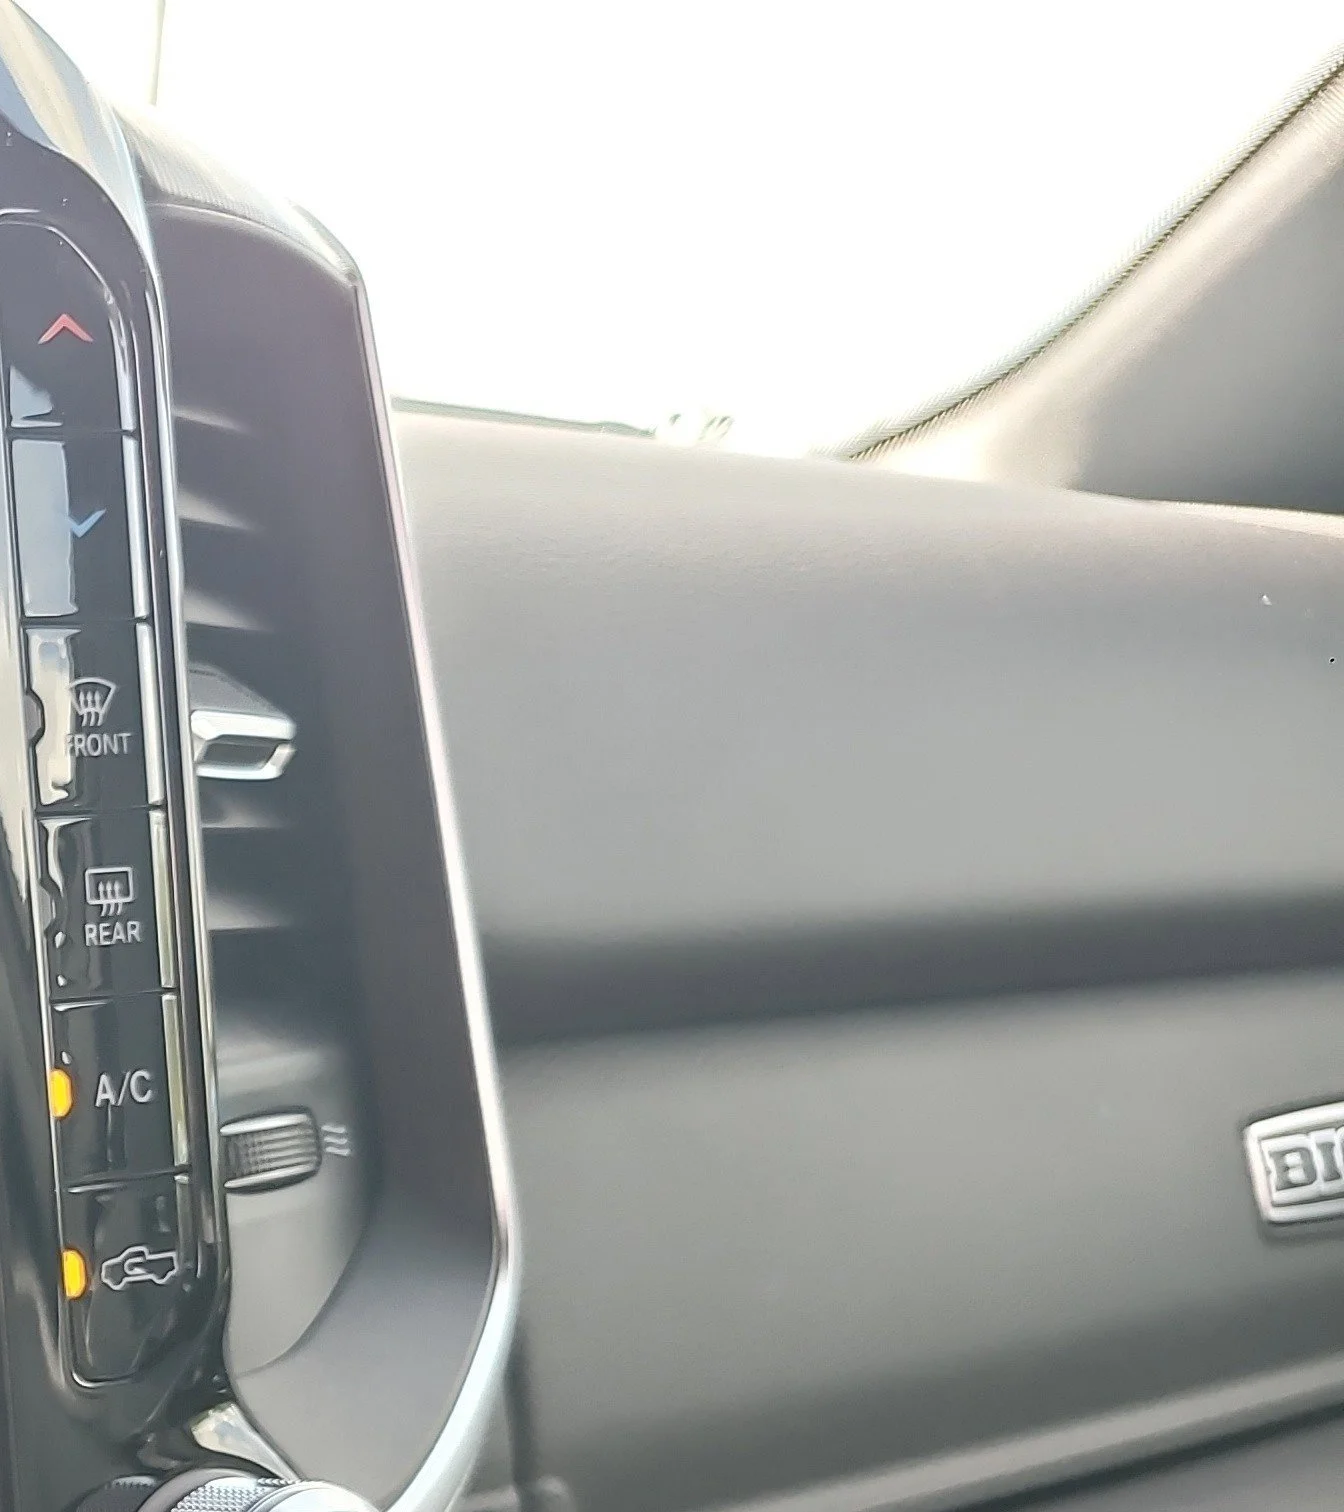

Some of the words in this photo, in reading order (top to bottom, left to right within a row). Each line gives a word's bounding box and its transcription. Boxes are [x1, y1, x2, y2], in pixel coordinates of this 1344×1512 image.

[67, 732, 132, 757] FRONT
[84, 921, 142, 947] REAR
[95, 1069, 153, 1107] A/C
